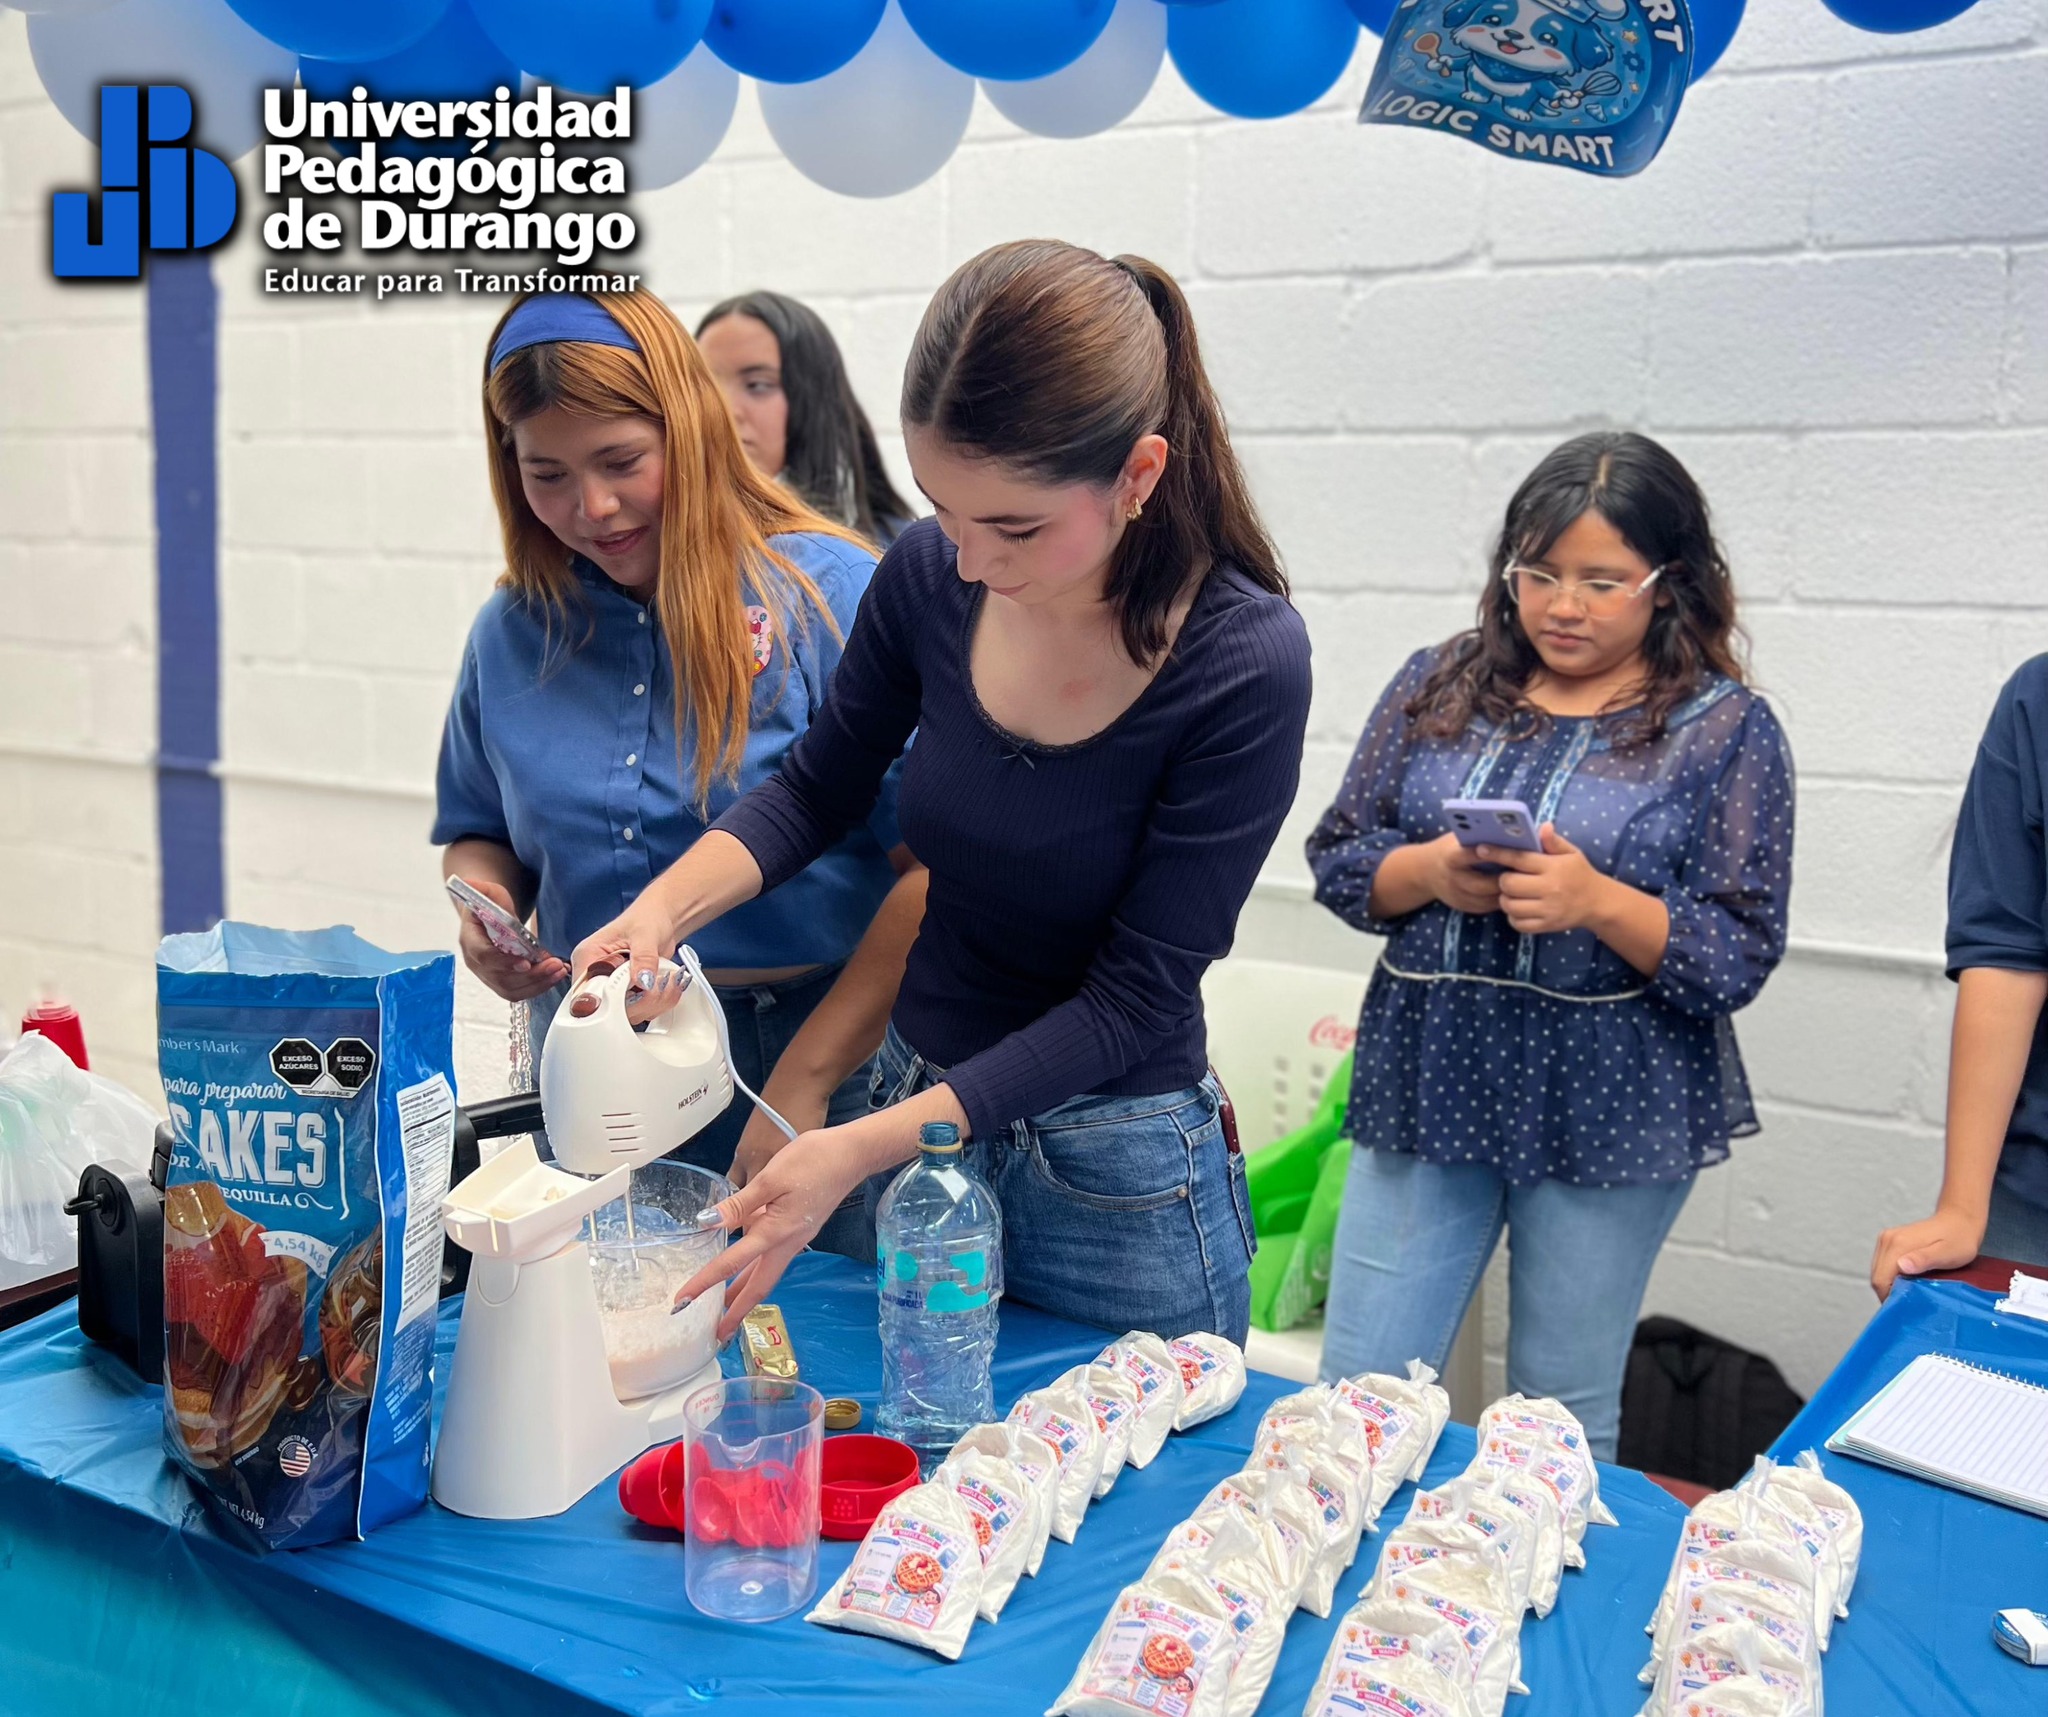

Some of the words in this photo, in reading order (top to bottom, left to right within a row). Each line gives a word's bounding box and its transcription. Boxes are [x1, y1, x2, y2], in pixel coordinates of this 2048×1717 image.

[1371, 90, 1478, 132] LOGIC
[1487, 123, 1614, 168] SMART
[203, 1040, 239, 1054] Mark
[282, 1055, 313, 1063] EXCESO
[336, 1055, 366, 1063] EXCESO
[341, 1063, 363, 1072] SODIO
[199, 1082, 287, 1108] preparar
[309, 1243, 327, 1269] kg
[889, 1514, 918, 1531] LOGIC
[1702, 1524, 1736, 1541] LOGIC
[1404, 1546, 1438, 1561] LOGIC
[1704, 1561, 1739, 1578] LOGIC
[1134, 1599, 1166, 1612] LOGIC
[1363, 1629, 1398, 1647] LOGIC
[1697, 1653, 1736, 1673] LOGIC
[1351, 1671, 1387, 1694] LOGIC
[1389, 1688, 1426, 1715] SMART
